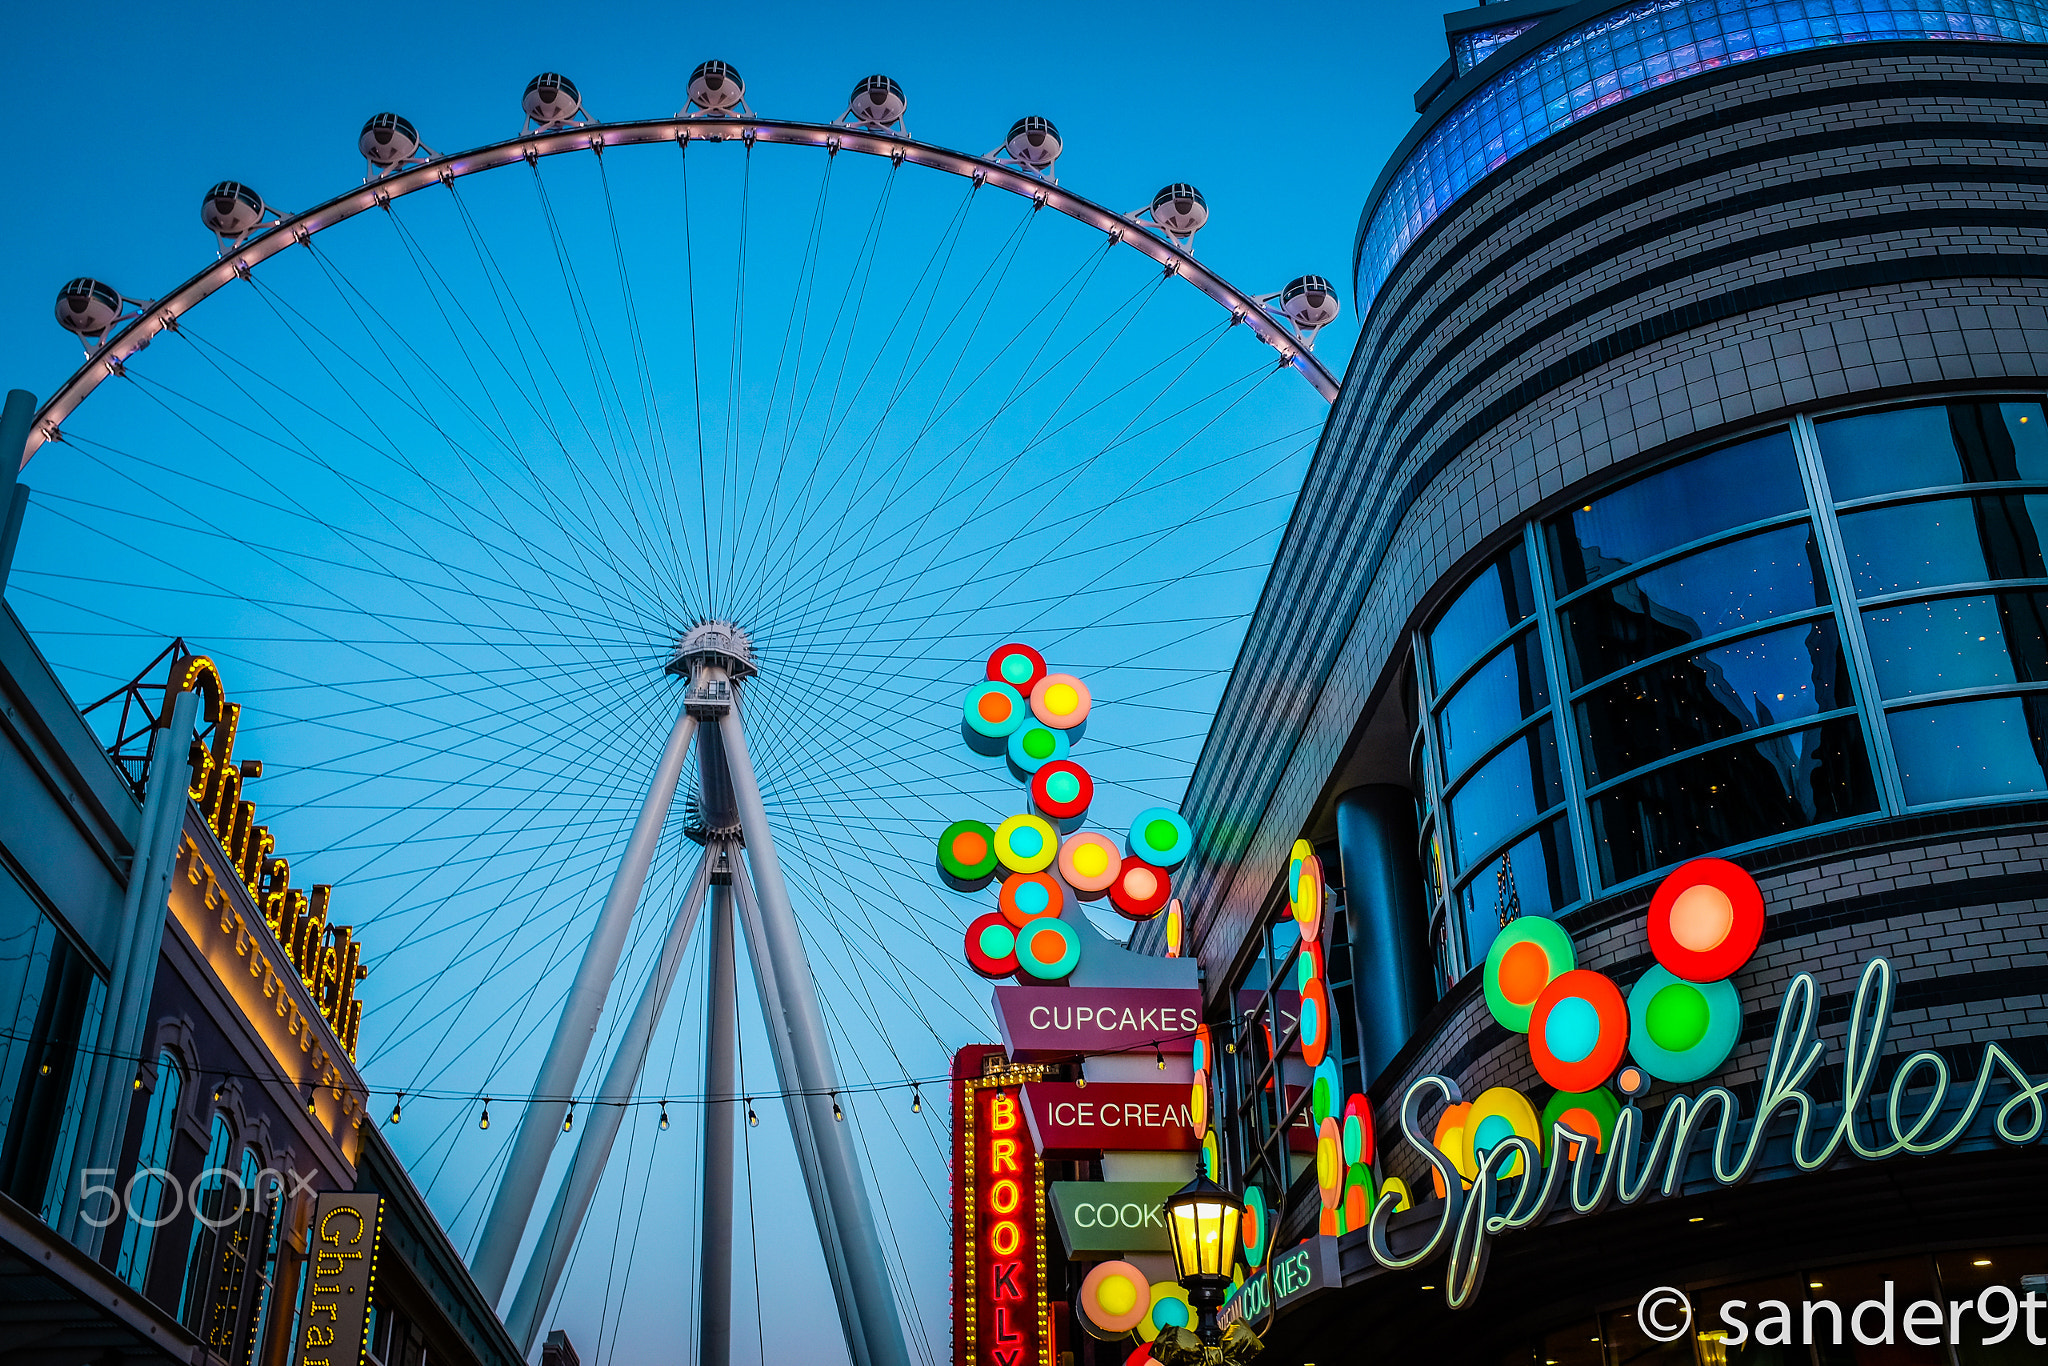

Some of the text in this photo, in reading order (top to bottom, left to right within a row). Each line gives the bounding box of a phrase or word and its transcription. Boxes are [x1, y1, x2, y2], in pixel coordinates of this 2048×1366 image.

[1029, 1005, 1198, 1032] CUPCAKES
[1048, 1102, 1095, 1127] ICE
[1367, 955, 2048, 1309] Sprinkles
[1074, 1202, 1167, 1229] COOK
[1242, 1250, 1311, 1321] COOKIES
